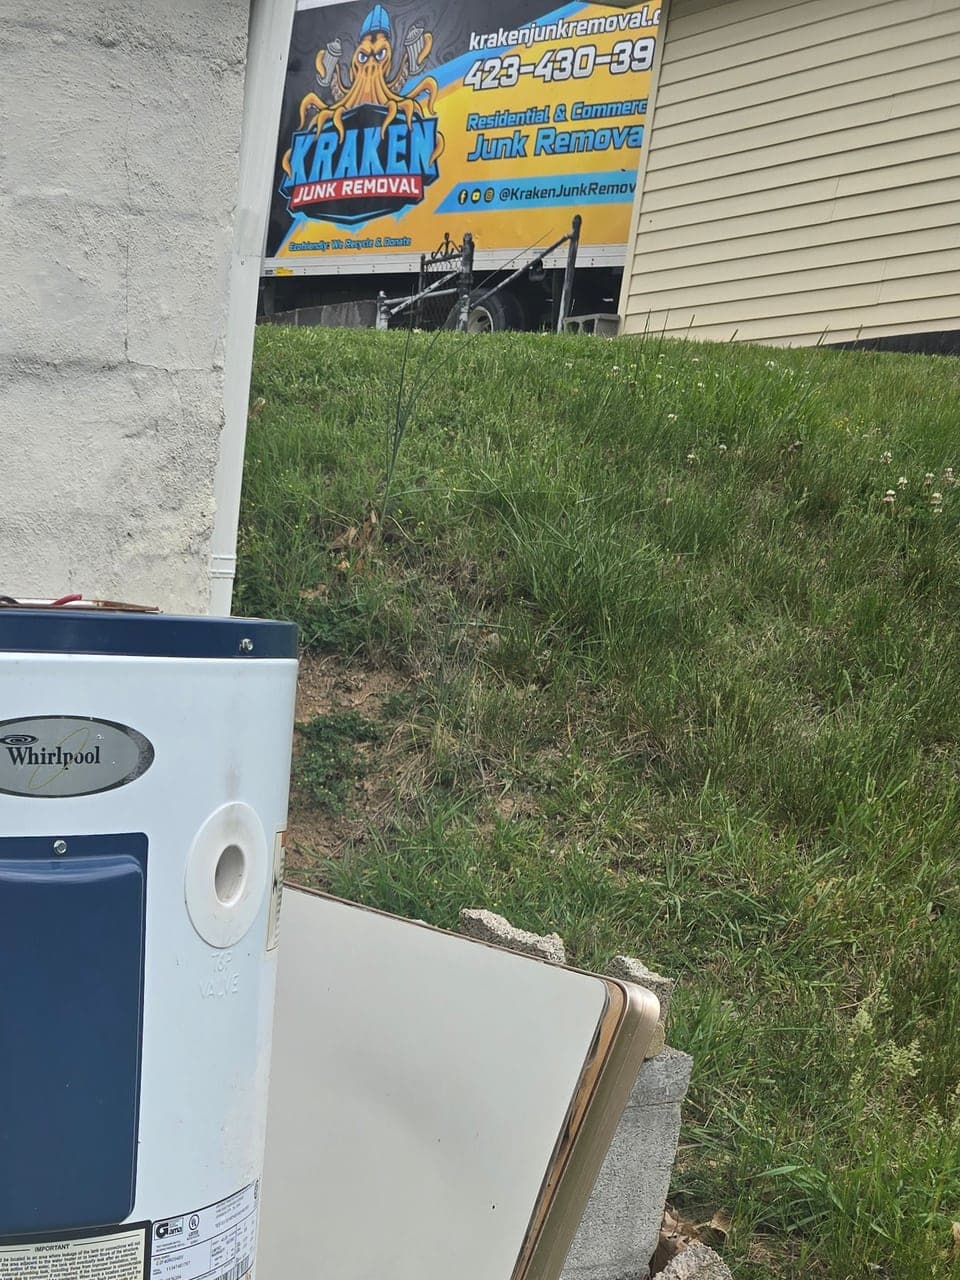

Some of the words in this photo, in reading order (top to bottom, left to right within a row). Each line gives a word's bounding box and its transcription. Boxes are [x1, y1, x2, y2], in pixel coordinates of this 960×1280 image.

[463, 37, 656, 91] 423-430-39
[466, 104, 551, 131] Residential
[554, 102, 569, 123] &
[283, 121, 438, 188] KRAKEN
[467, 129, 529, 162] Junk
[533, 125, 645, 156] Remova
[294, 183, 337, 203] JUNK
[342, 178, 420, 195] REMOVAL
[5, 746, 102, 770] Whirlpool
[199, 972, 241, 999] VALVE
[34, 1244, 70, 1252] IMPORTANT
